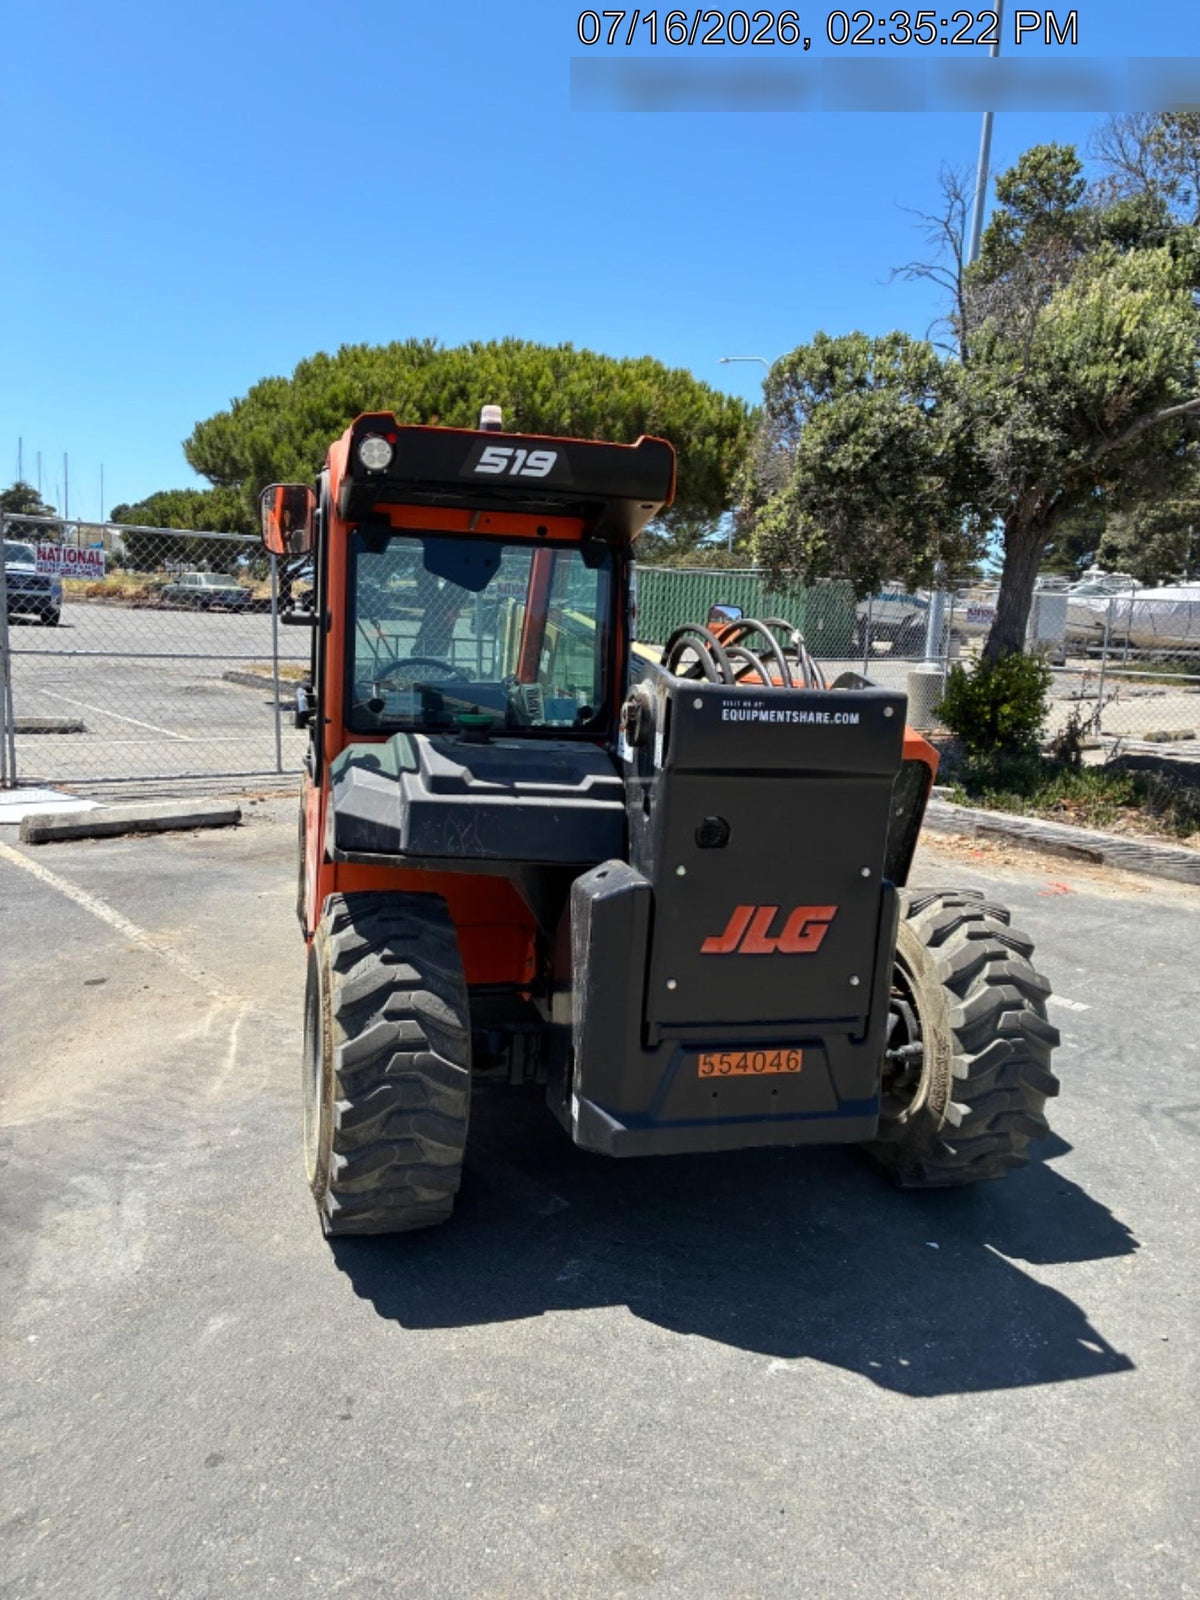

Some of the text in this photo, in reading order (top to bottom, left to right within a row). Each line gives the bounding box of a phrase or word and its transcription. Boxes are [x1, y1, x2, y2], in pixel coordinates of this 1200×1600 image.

[474, 445, 557, 478] 519
[36, 547, 104, 566] NATIONAL
[721, 708, 860, 725] EQUIPMENTSHARE.COM
[700, 904, 838, 954] JLG
[701, 1051, 800, 1075] 554046
